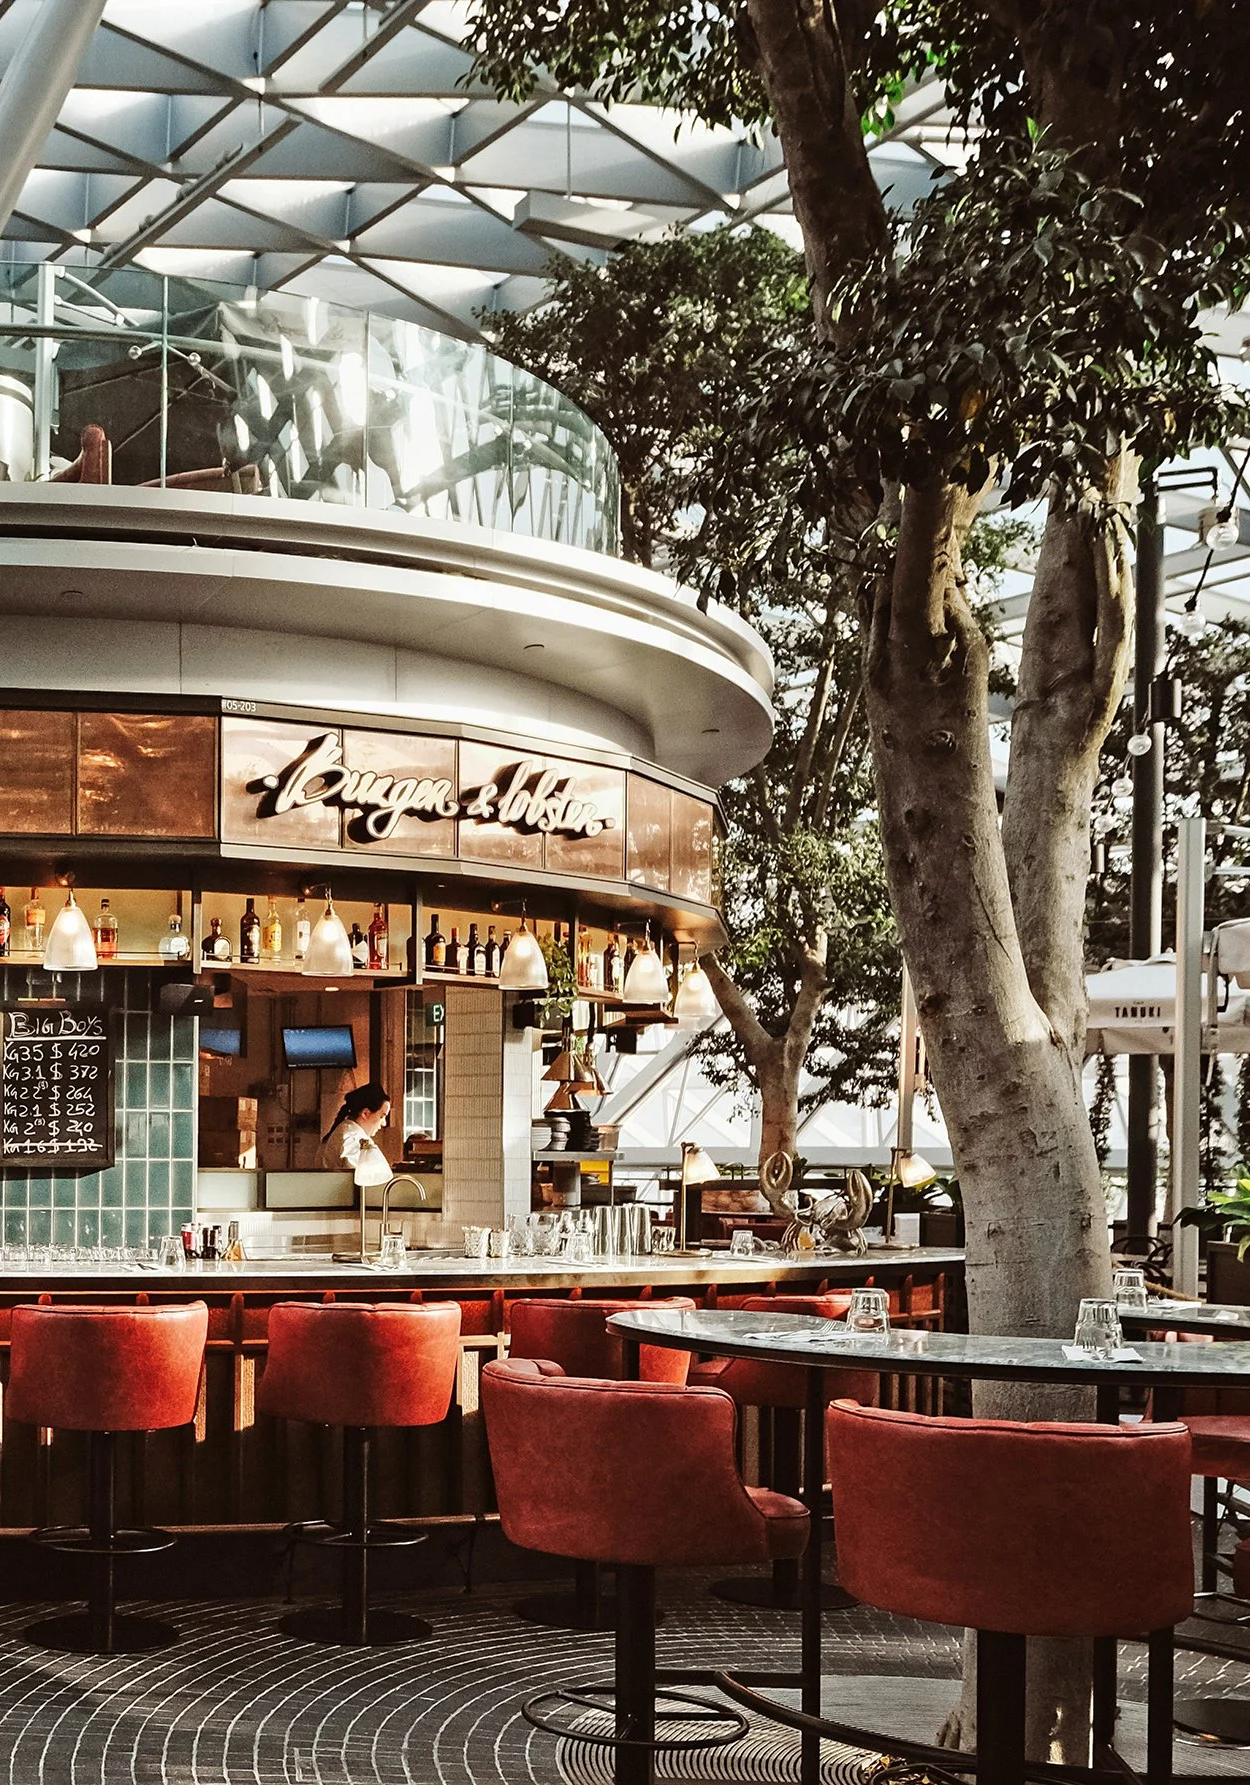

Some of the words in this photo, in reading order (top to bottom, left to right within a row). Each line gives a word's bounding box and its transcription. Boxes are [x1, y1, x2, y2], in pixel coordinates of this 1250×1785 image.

[275, 732, 459, 839] Burger
[467, 786, 494, 817] &
[1114, 1006, 1161, 1018] TANUKI
